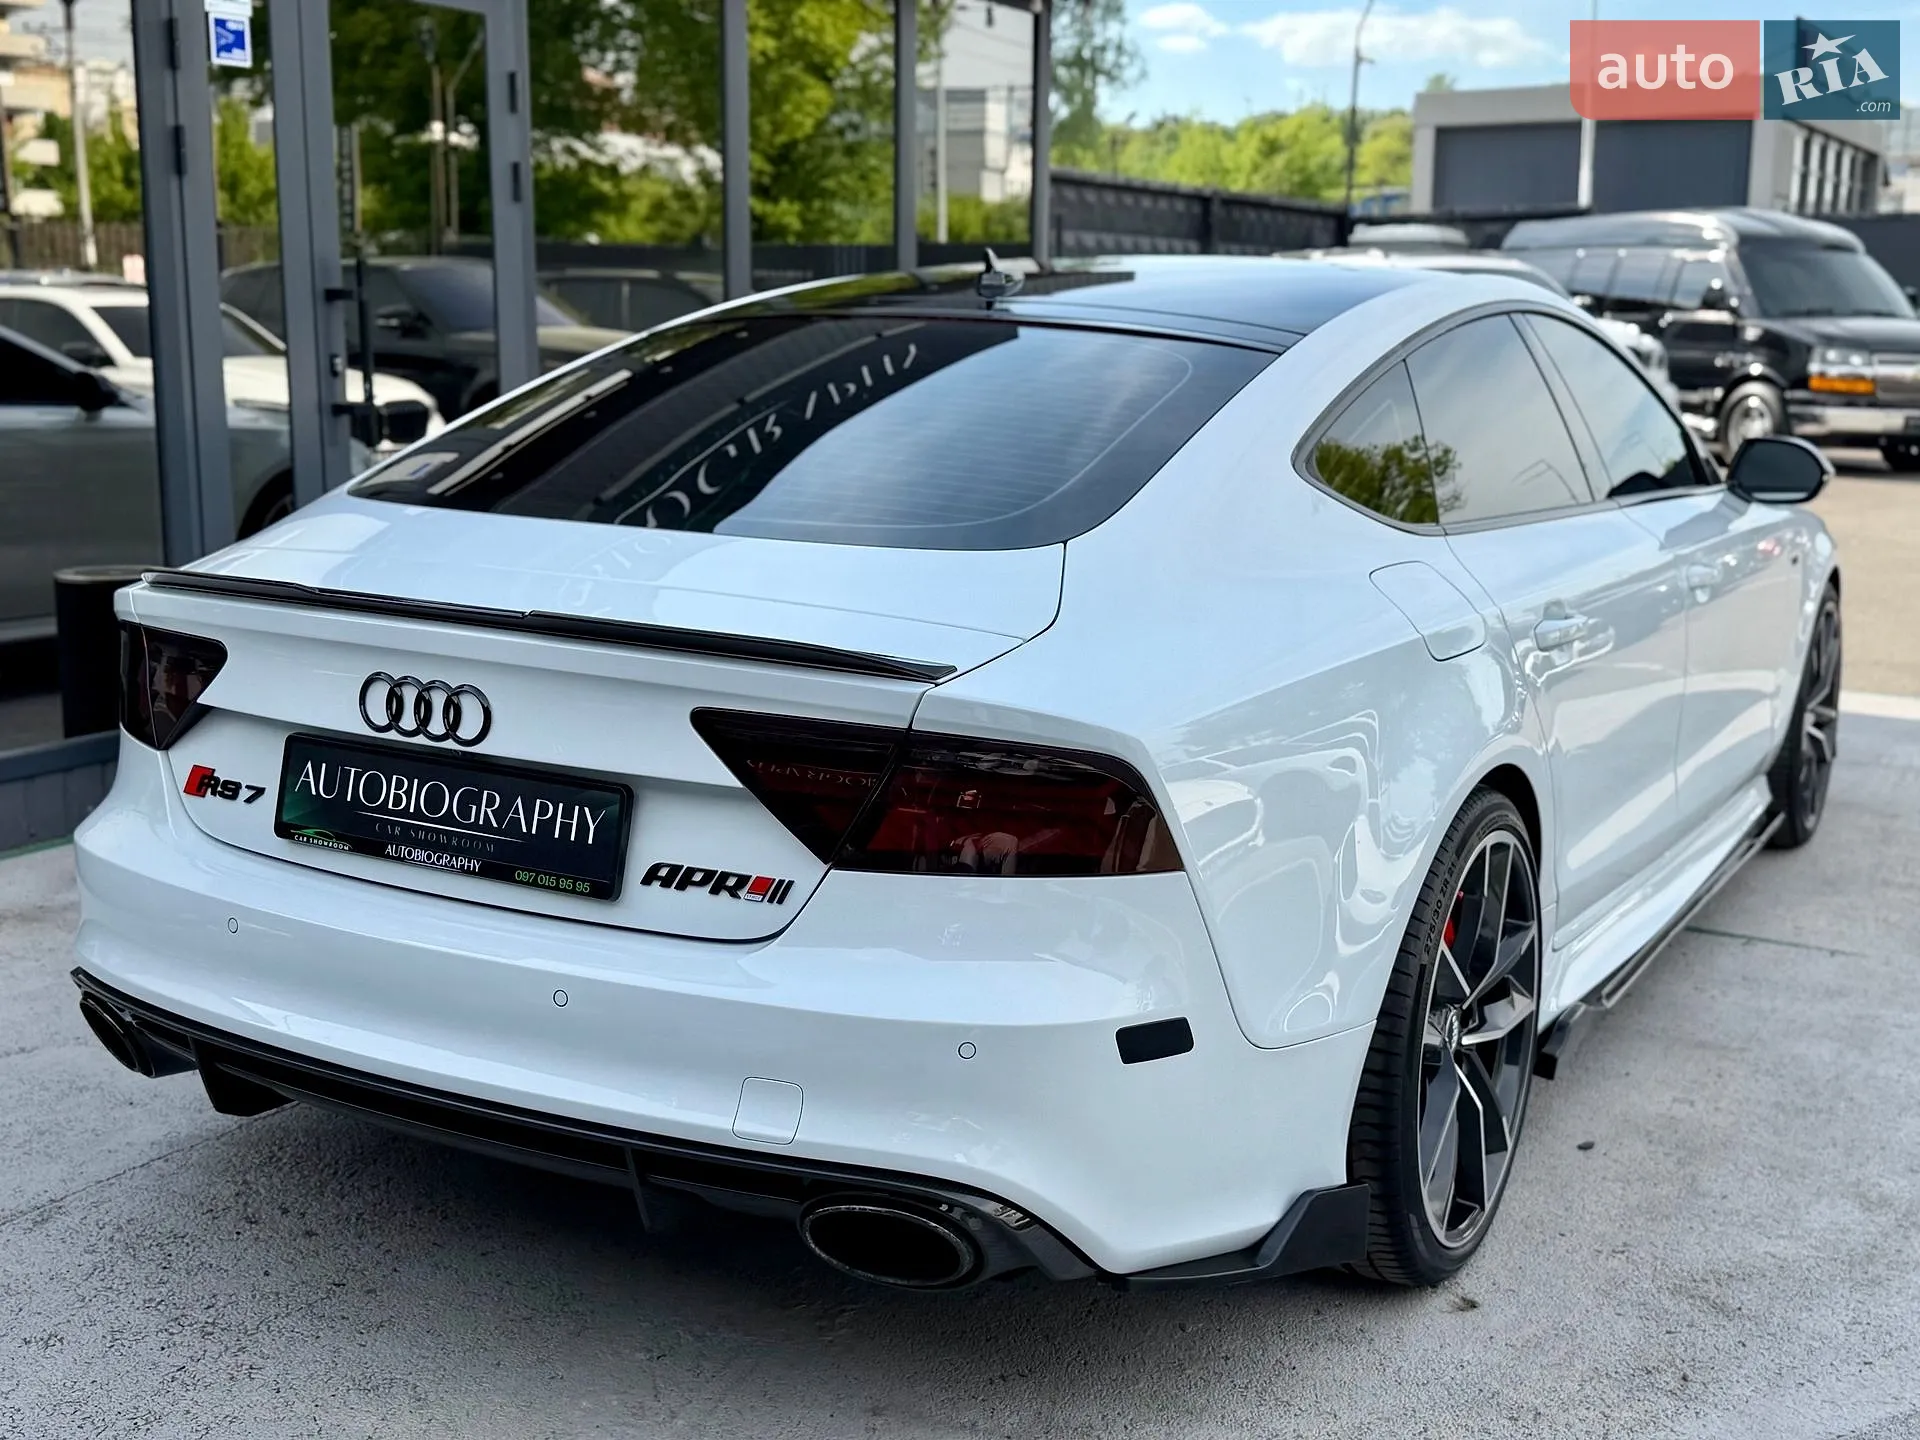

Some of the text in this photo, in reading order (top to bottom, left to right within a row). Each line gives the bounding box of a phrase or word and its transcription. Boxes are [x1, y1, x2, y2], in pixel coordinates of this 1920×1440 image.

[294, 759, 606, 845] AUTOBIOGRAPHY
[294, 834, 350, 851] CAR SHOWROOM
[375, 822, 495, 853] CAR SHOWROOM
[384, 843, 482, 873] AUTOBIOGRAPHY
[514, 869, 591, 894] 097 015 95 95
[640, 861, 752, 900] APR
